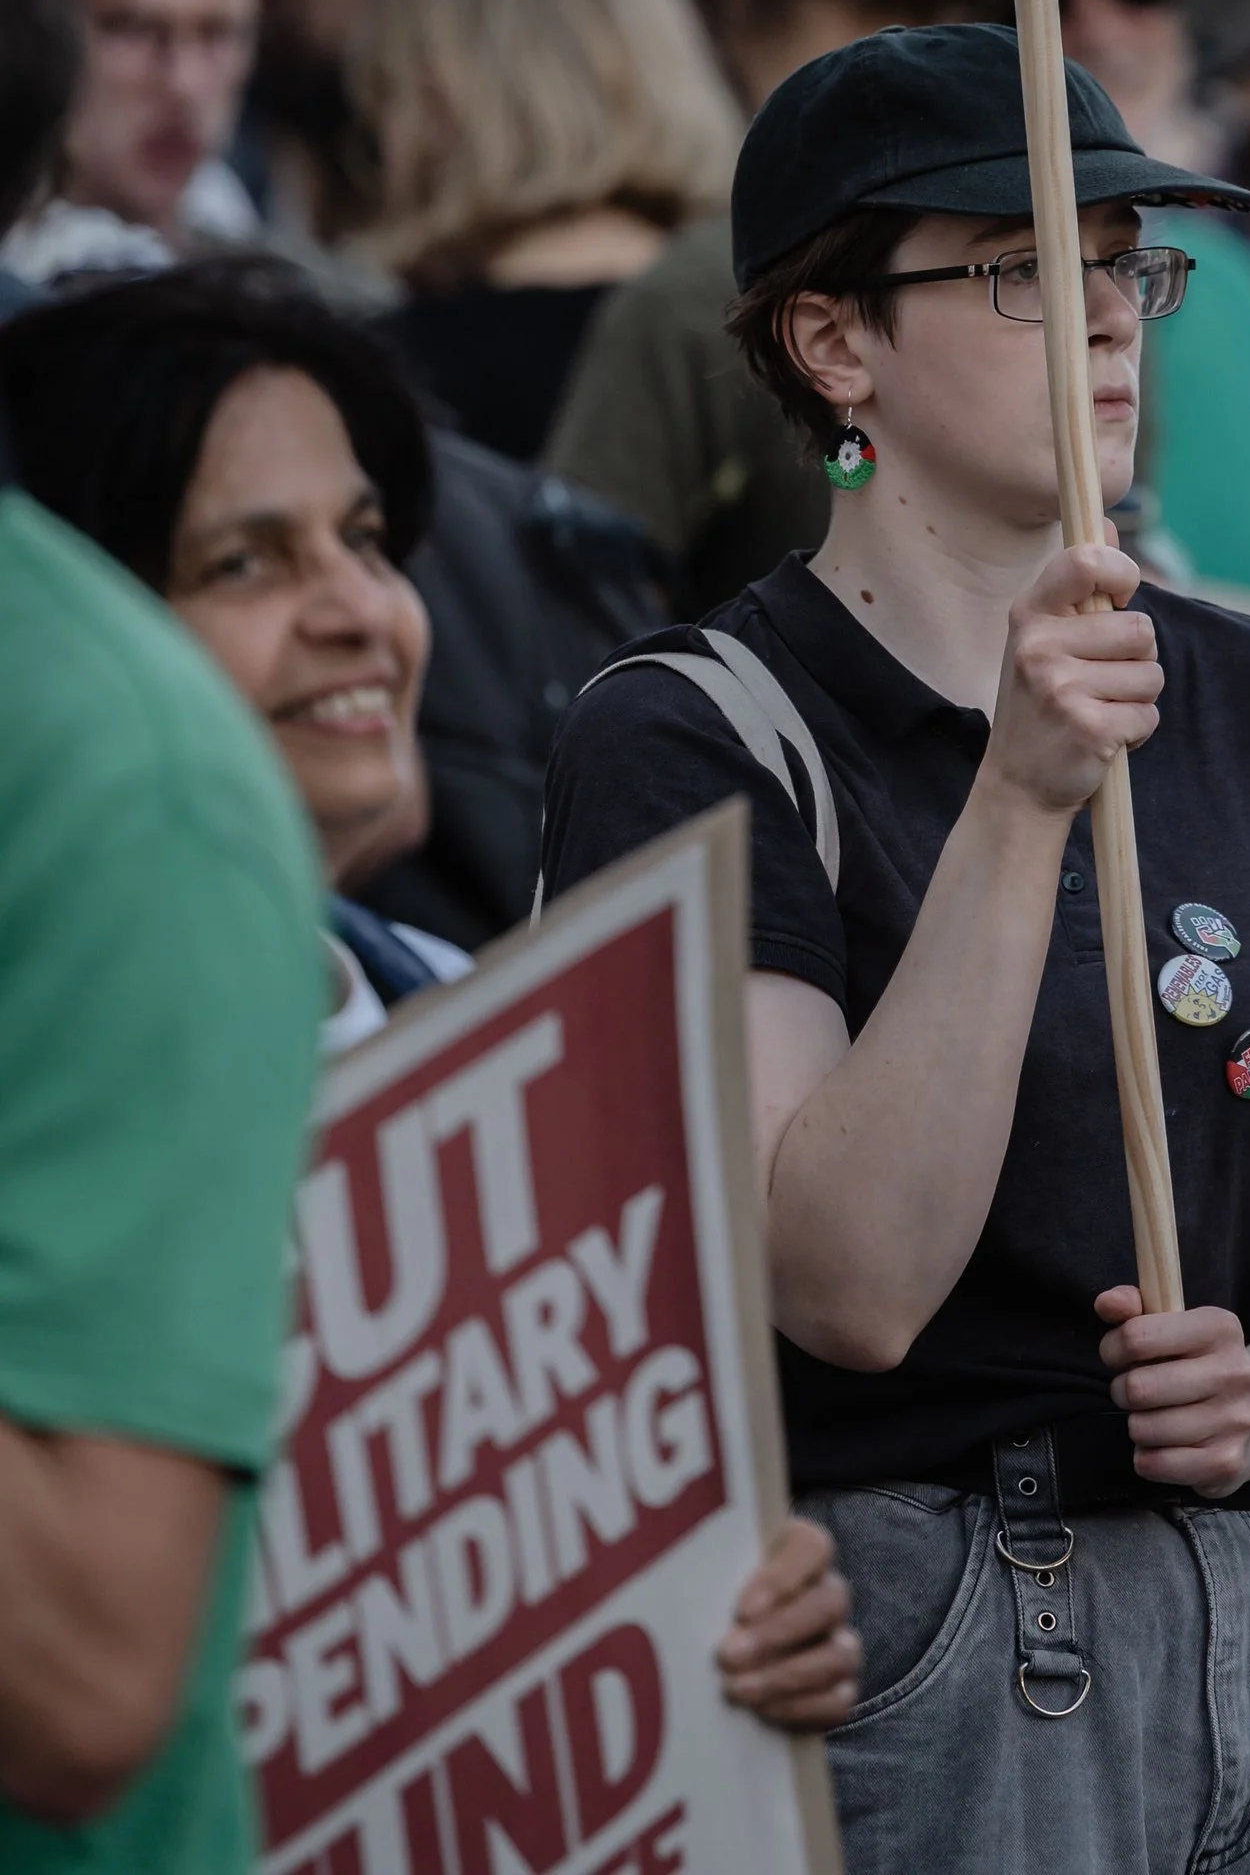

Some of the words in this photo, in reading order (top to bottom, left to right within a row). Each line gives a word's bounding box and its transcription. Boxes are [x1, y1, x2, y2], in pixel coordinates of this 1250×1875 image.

[245, 1183, 665, 1631] LITARY
[278, 1007, 564, 1430] UT
[232, 1344, 714, 1777] PENDING
[262, 1619, 665, 1875] ND
